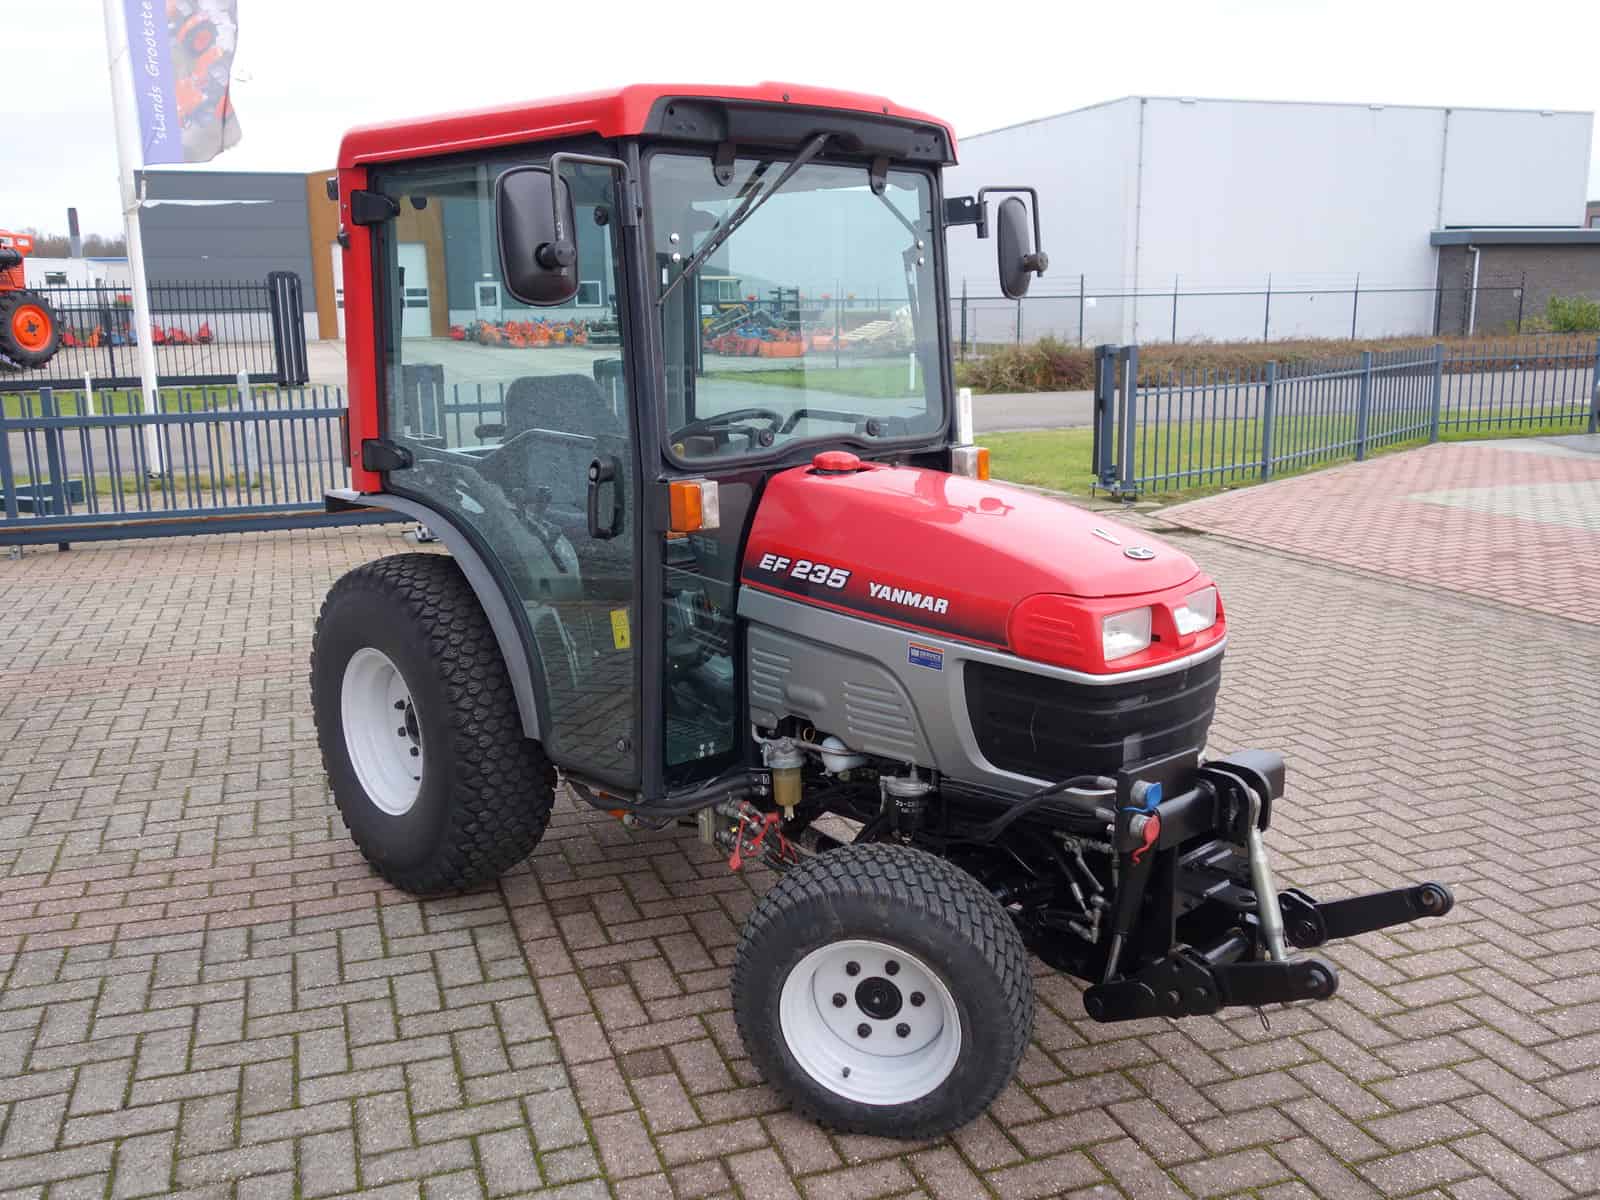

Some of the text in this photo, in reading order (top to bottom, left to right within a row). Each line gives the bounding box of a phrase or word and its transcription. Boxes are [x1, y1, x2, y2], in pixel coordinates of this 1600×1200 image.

[759, 553, 851, 588] EF 235
[869, 581, 949, 614] YANMAR
